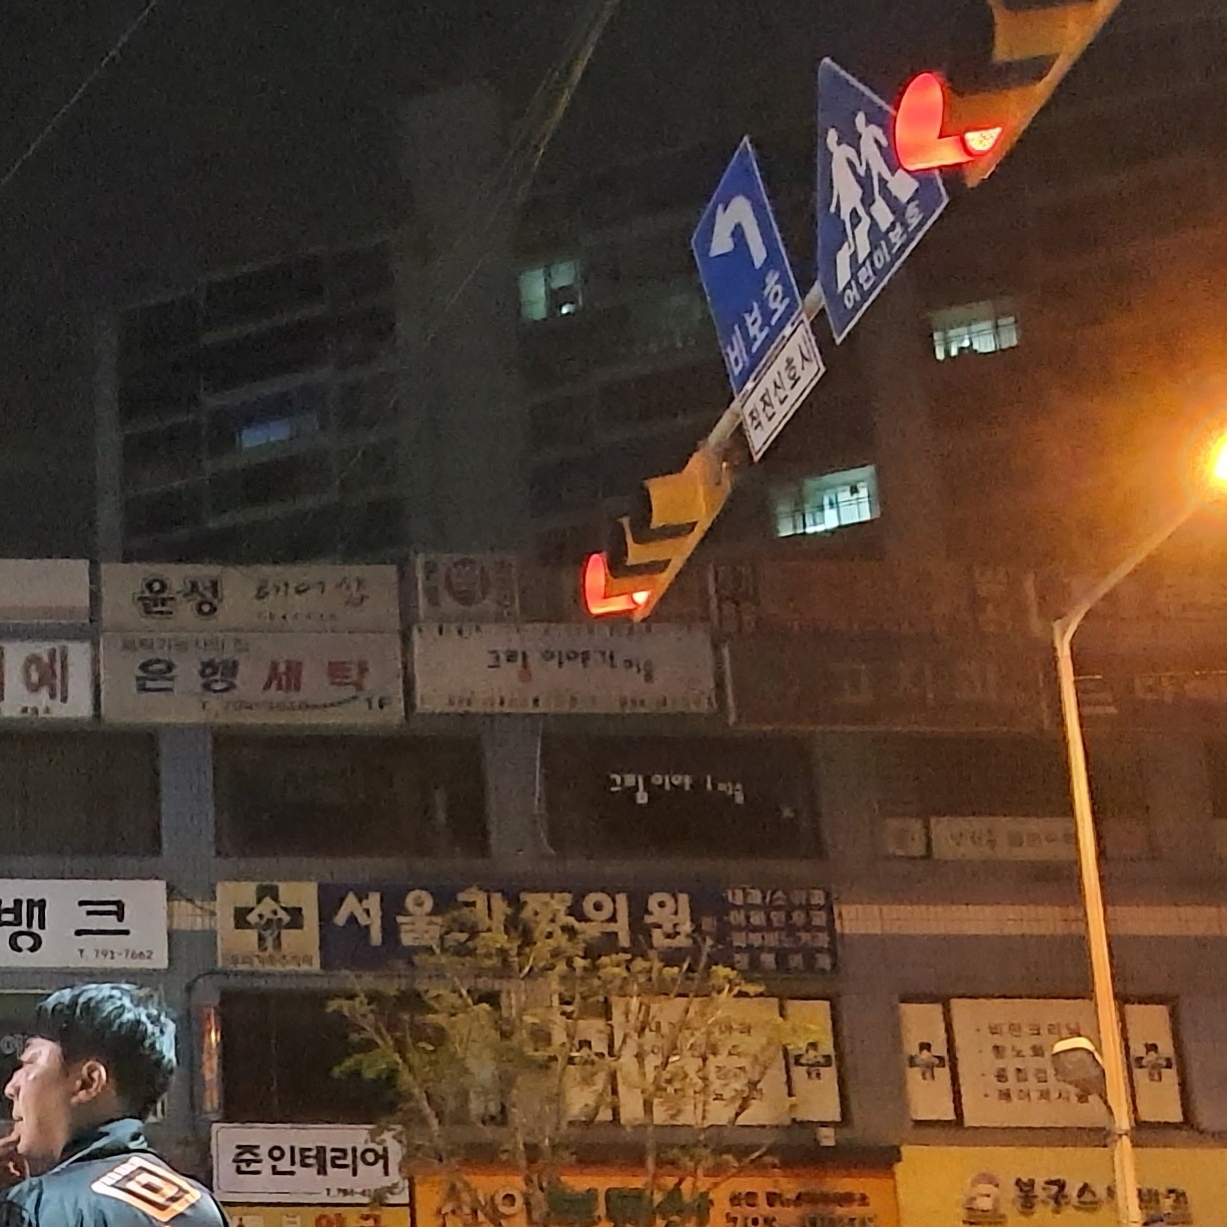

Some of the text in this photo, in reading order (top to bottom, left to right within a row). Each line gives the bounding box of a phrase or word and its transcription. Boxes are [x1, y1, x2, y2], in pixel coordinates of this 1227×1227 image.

[842, 198, 925, 312] 어린이보호
[724, 269, 791, 377] 비보호
[747, 334, 815, 433] 직진신호시
[134, 657, 371, 694] 은행세탁
[231, 1143, 390, 1177] 준인테리어
